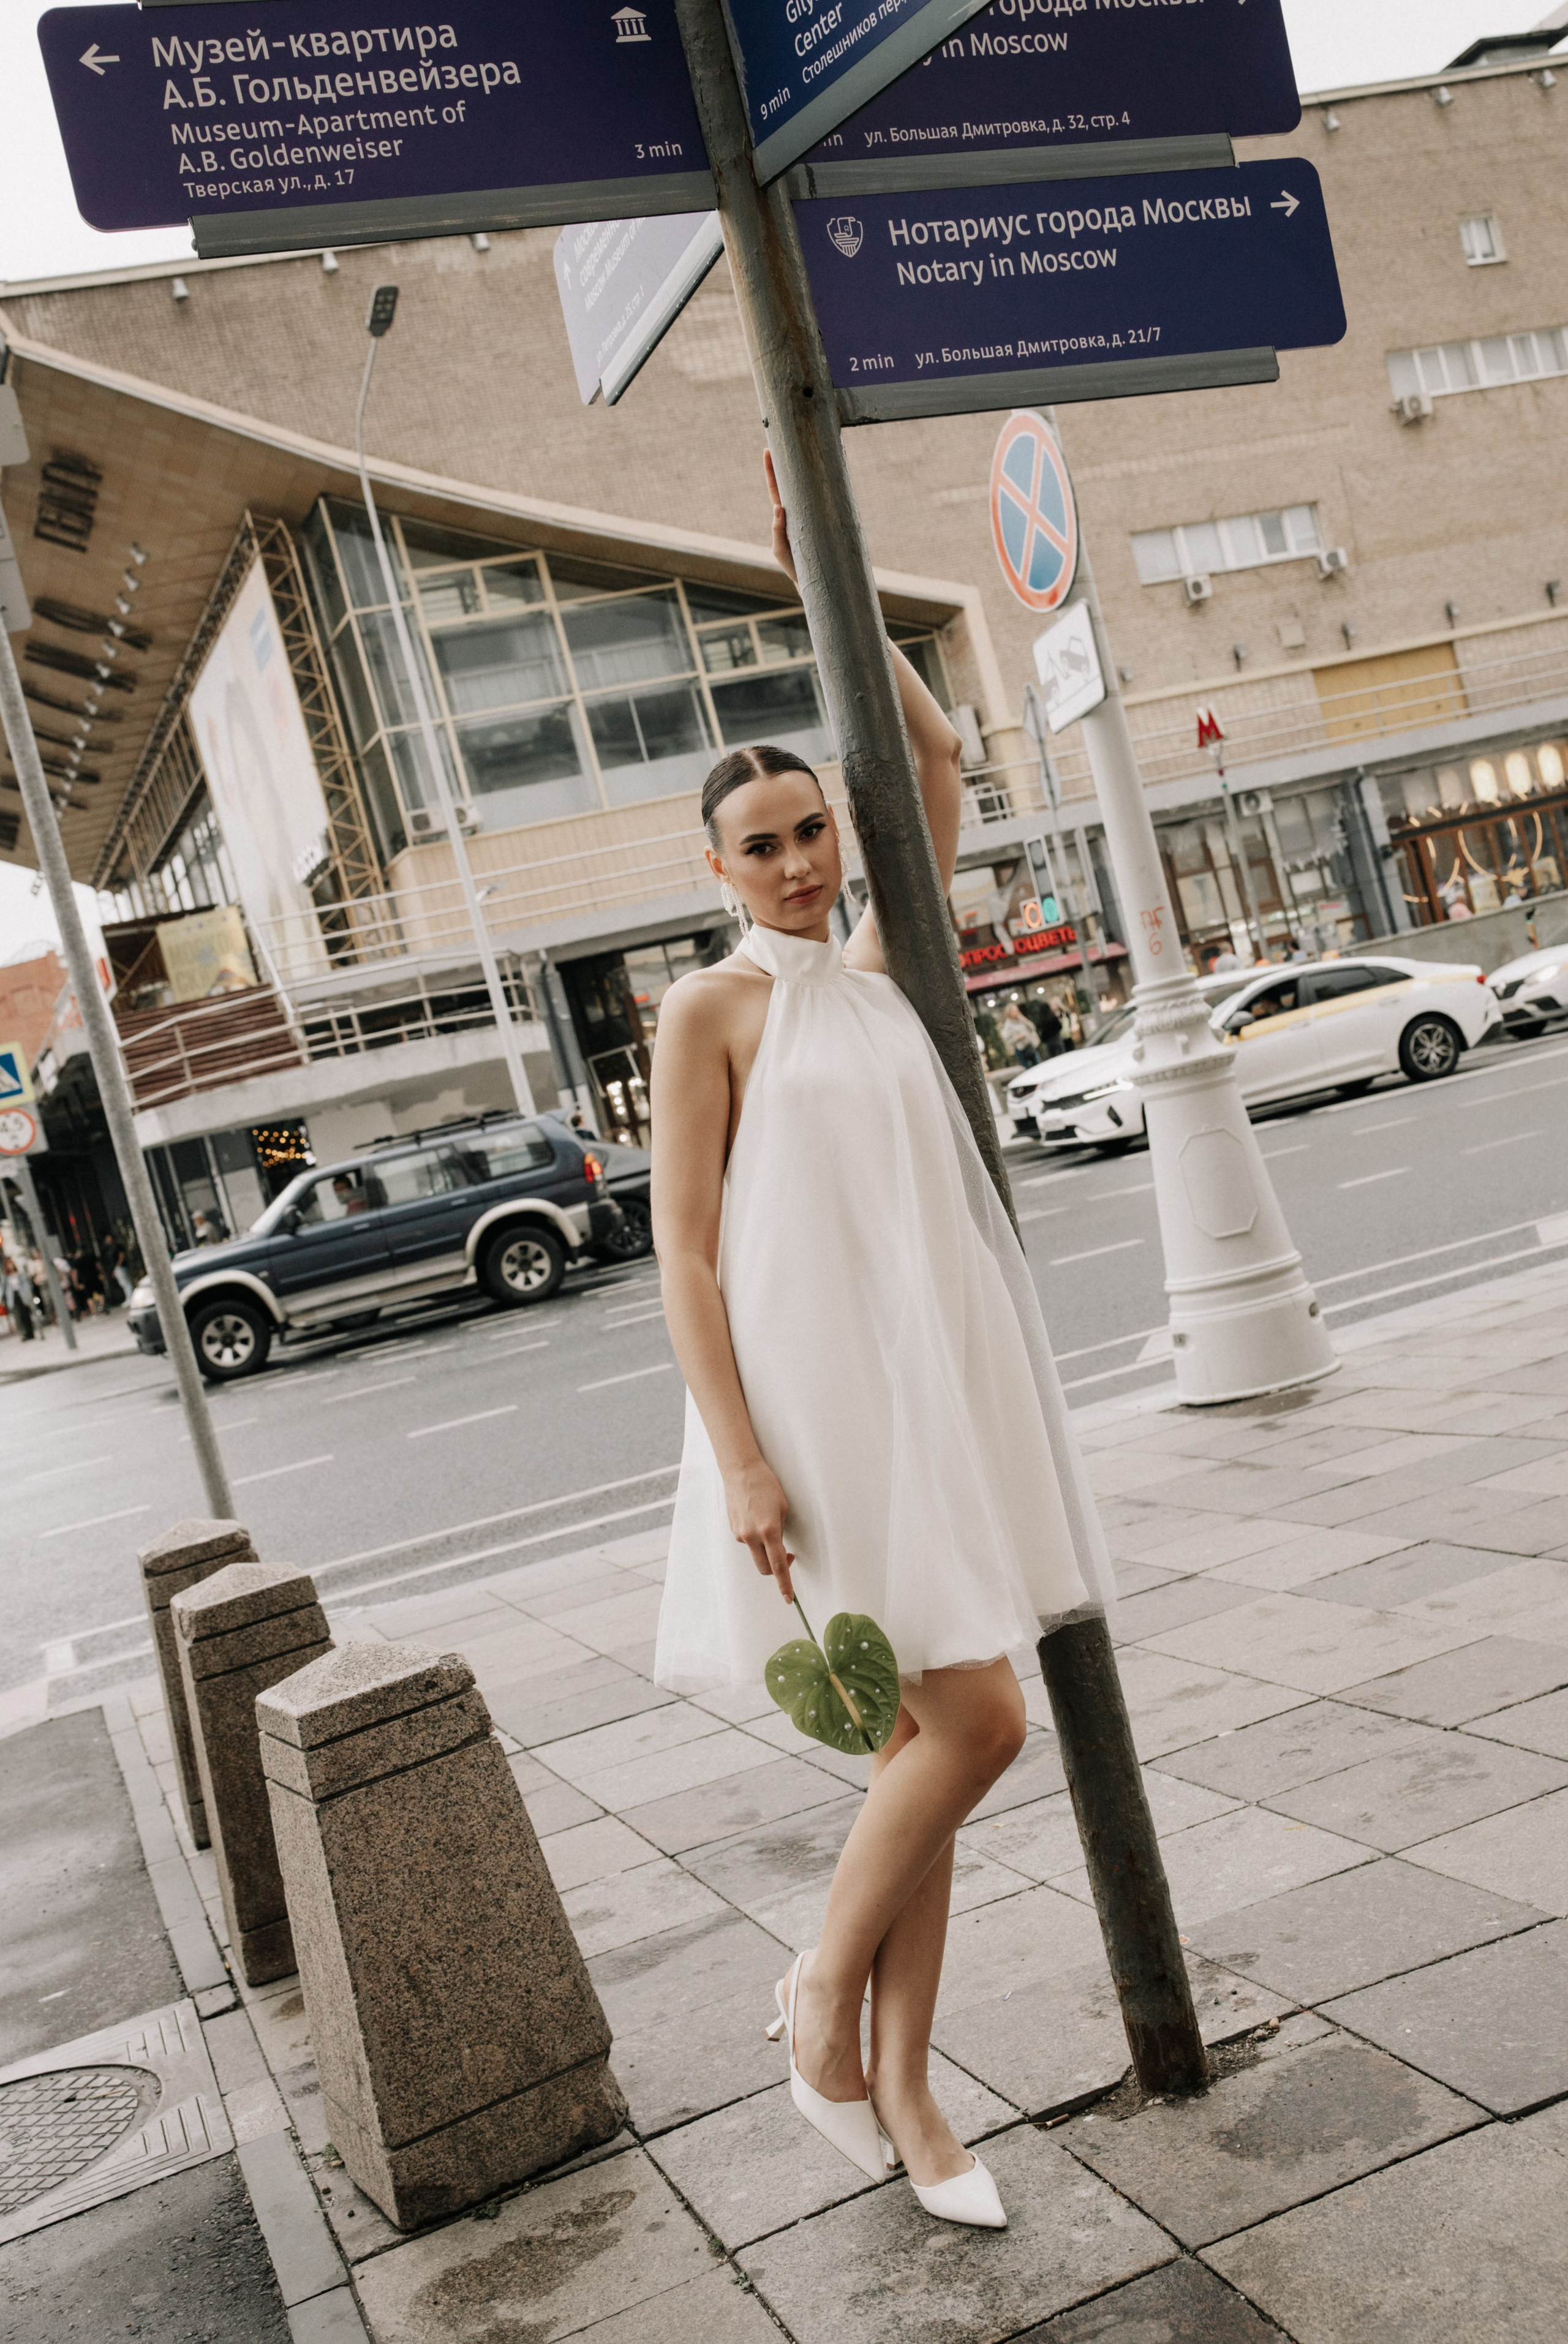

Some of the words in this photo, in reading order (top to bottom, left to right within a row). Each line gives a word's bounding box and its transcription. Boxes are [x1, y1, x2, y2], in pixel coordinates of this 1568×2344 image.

[151, 24, 458, 74] Музей-квартира
[794, 2, 842, 56] Center
[802, 12, 878, 83] Столешников
[970, 32, 1068, 56] Moscow
[163, 77, 226, 110] А.Б.
[232, 59, 521, 105] Гольденвейзера
[761, 104, 767, 120] 9
[769, 87, 791, 113] min
[171, 105, 438, 149] Museum-Apartment
[442, 100, 466, 124] of
[864, 131, 887, 148] ул.
[889, 126, 958, 142] Большая
[962, 119, 1050, 140] Дмитровка,
[1052, 119, 1065, 133] д.
[1067, 115, 1089, 130] 32,
[1091, 115, 1119, 130] стр.
[1121, 111, 1131, 125] 4
[179, 151, 225, 174] A.B.
[230, 137, 403, 170] Goldenweiser
[635, 144, 645, 159] 3
[649, 141, 682, 157] min
[183, 178, 275, 200] Тверская
[334, 168, 354, 186] 17
[888, 214, 1031, 248] Нотариус
[1036, 206, 1136, 239] города
[1142, 196, 1251, 225] Москвы
[584, 271, 607, 314] Moscow
[604, 232, 631, 281] Museum
[896, 259, 984, 286] Notary
[989, 252, 1015, 278] in
[1020, 248, 1117, 274] Moscow
[849, 357, 859, 372] 2
[862, 353, 894, 371] min
[914, 353, 939, 368] ул.
[941, 344, 1014, 363] Большая
[1017, 335, 1110, 358] Дмитровка,
[1112, 334, 1126, 349] д.
[1128, 326, 1161, 344] 21/7
